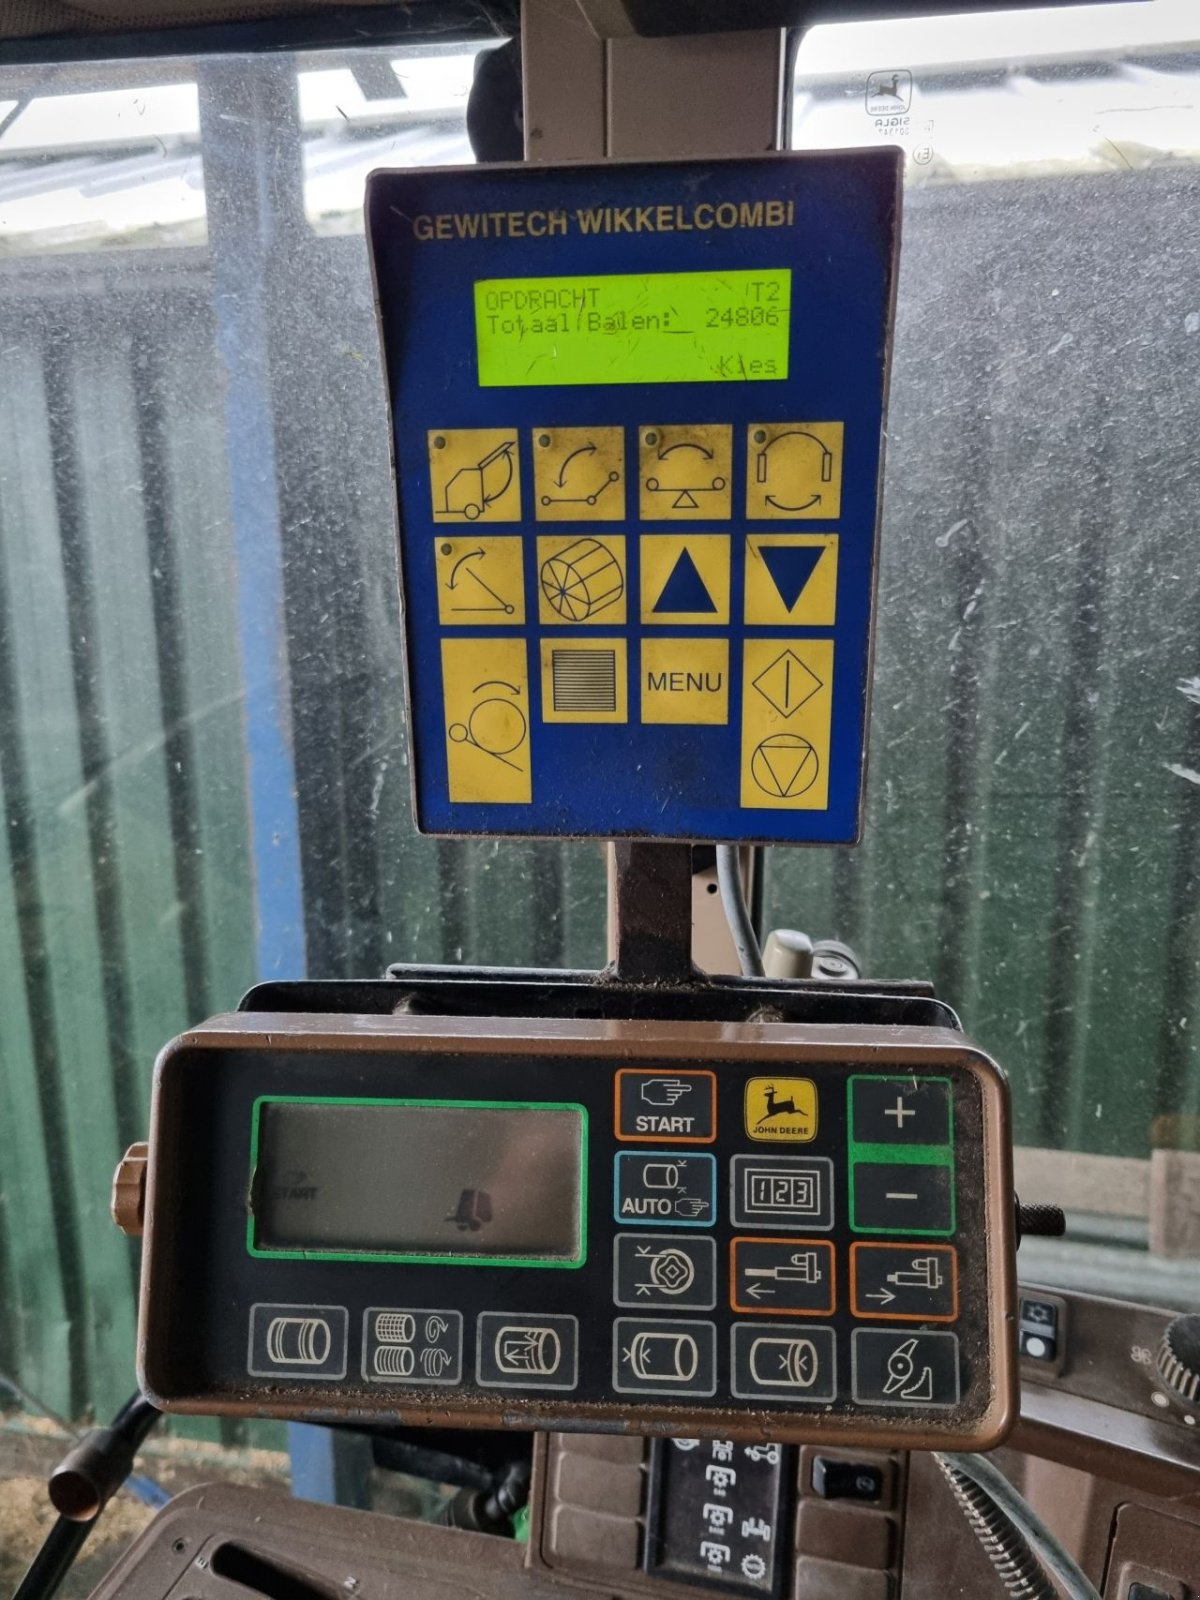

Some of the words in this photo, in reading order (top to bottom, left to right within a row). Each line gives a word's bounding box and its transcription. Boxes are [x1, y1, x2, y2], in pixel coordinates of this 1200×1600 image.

[413, 210, 567, 240] GEWITECH
[485, 288, 600, 310] OPDRACHT
[751, 281, 779, 302] T2
[486, 312, 570, 334] Totaal
[587, 308, 671, 332] Balen:
[705, 306, 779, 328] 24806
[648, 672, 722, 692] MENU
[636, 1116, 694, 1133] START
[753, 1126, 777, 1134] JOHN
[779, 1126, 809, 1135] DEERE
[621, 1198, 671, 1215] AUTO
